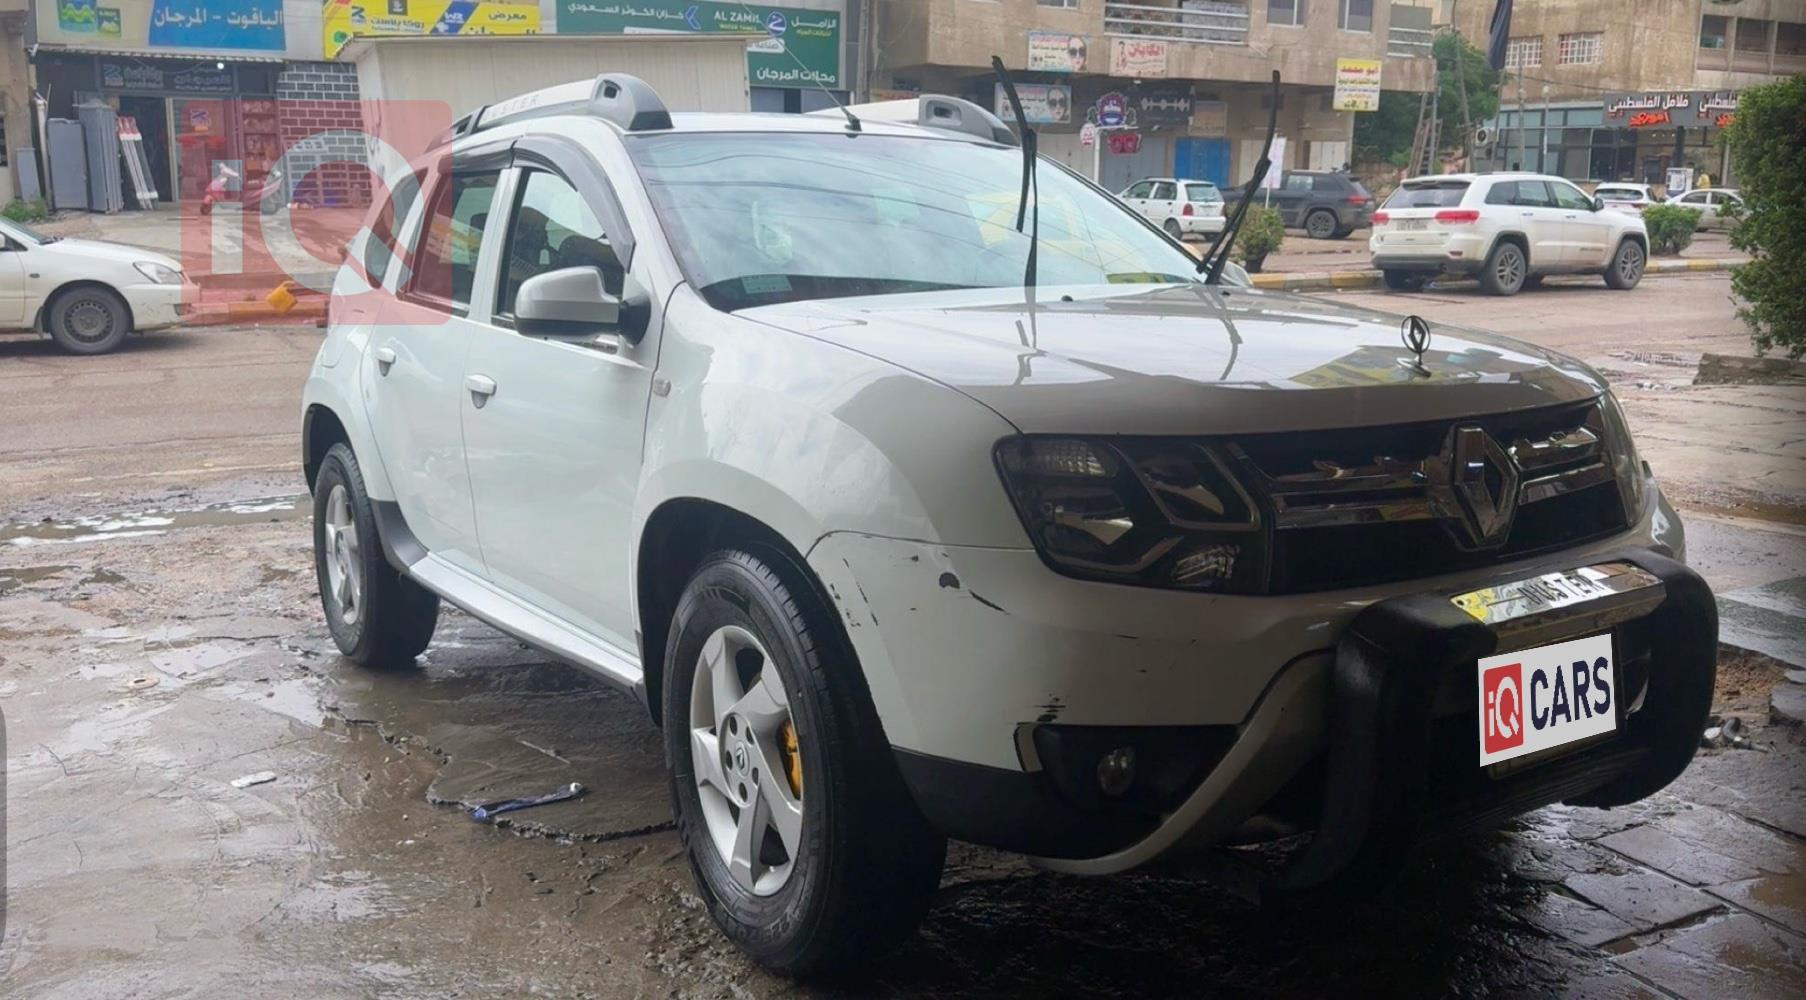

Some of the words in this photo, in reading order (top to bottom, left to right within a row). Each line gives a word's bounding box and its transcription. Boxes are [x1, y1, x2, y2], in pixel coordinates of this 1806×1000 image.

[154, 7, 207, 28] المرجان
[488, 10, 527, 21] معرض
[714, 11, 728, 21] AL
[791, 16, 837, 29] الزامل
[756, 67, 798, 81] المرجان
[800, 68, 836, 83] محلات
[1662, 93, 1689, 110] فلافل
